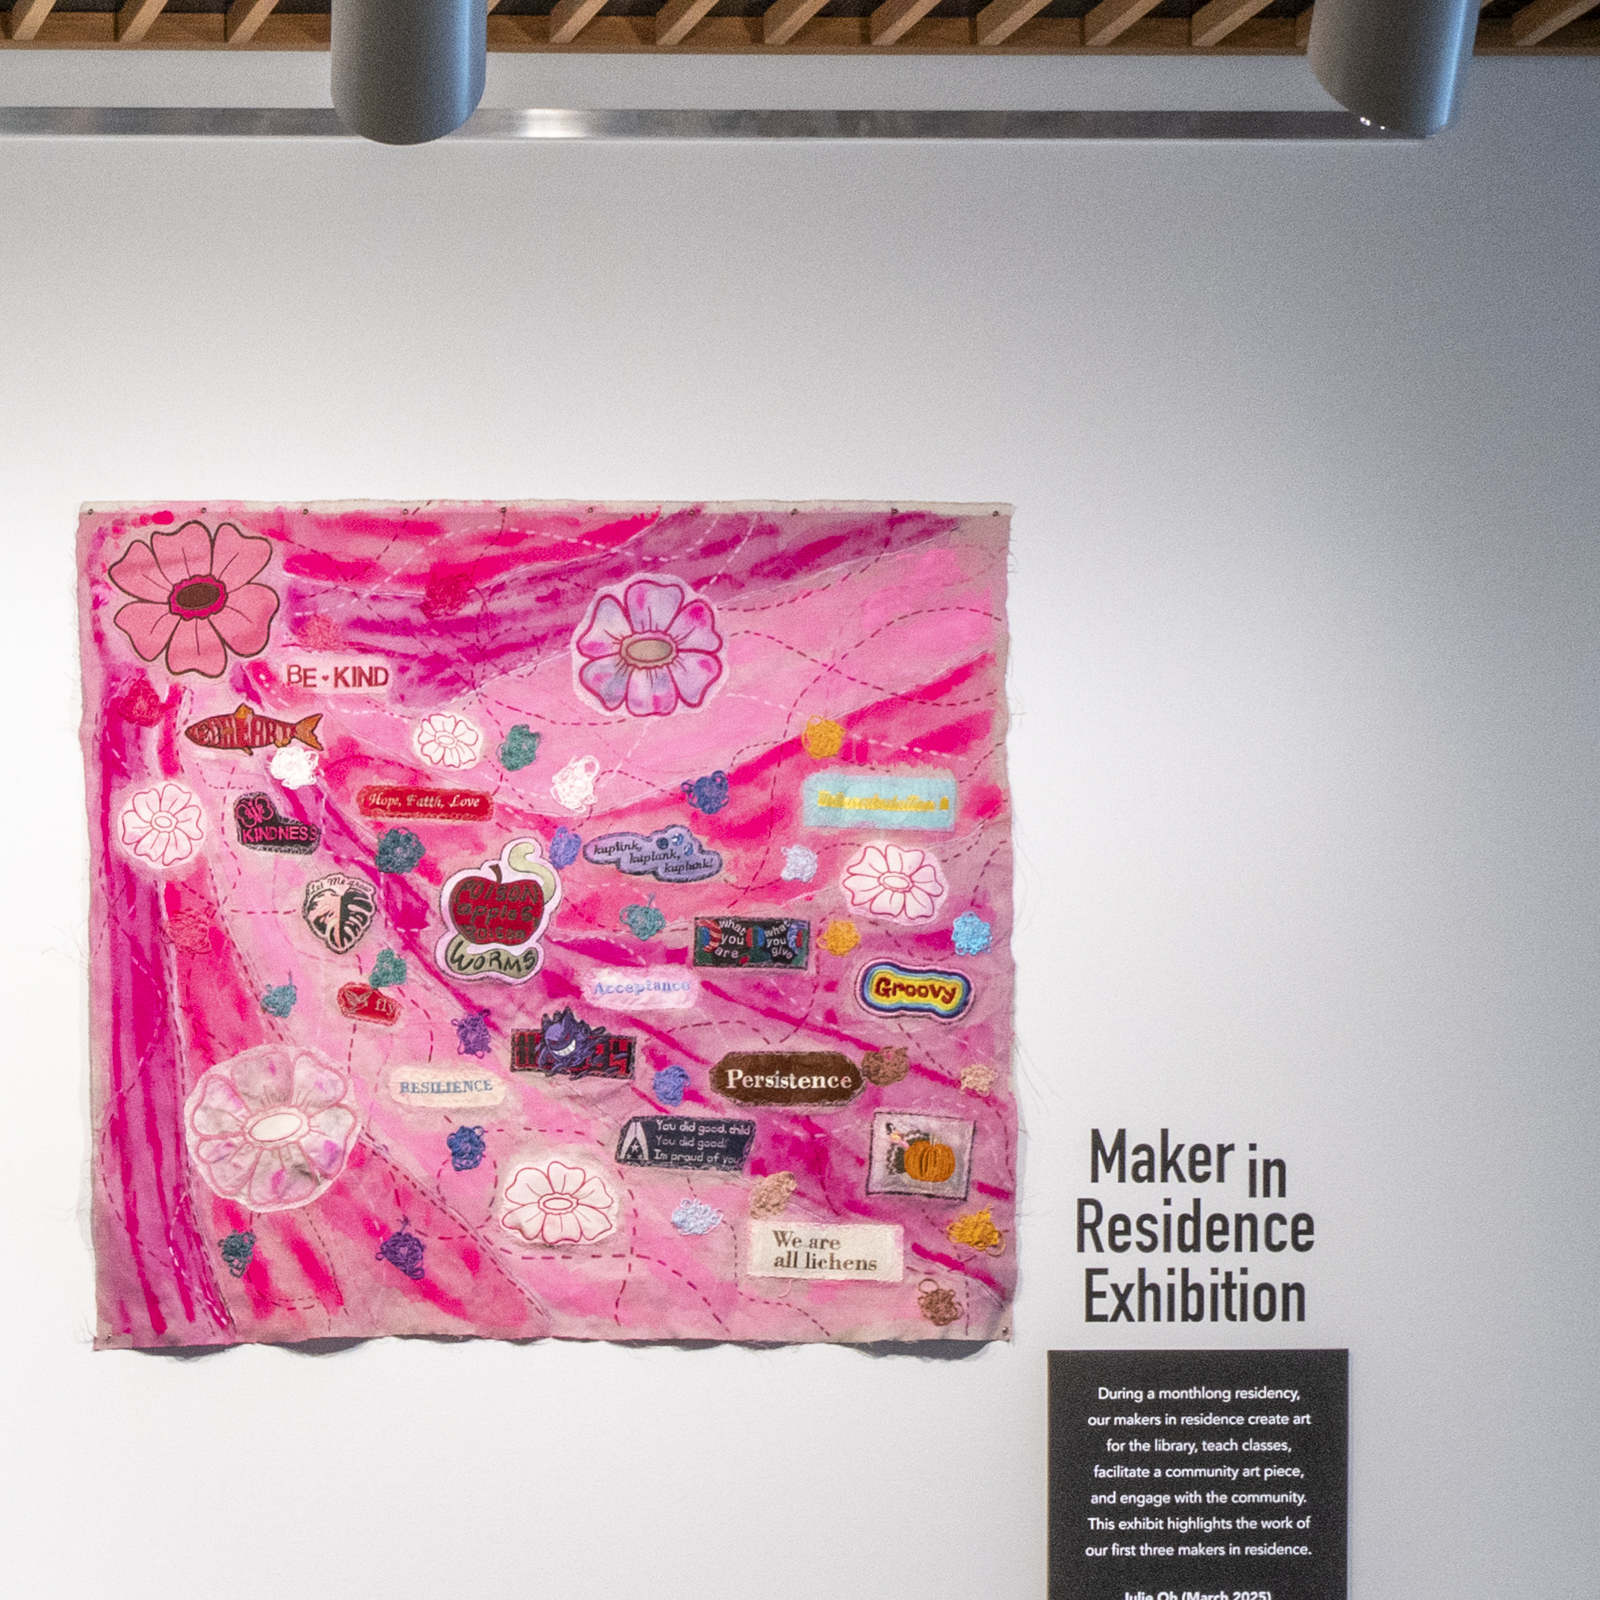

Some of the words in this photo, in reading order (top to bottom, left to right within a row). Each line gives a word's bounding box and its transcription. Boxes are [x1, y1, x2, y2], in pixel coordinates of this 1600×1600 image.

[286, 664, 317, 687] BE
[333, 665, 389, 688] KIND
[368, 791, 402, 810] Hope,
[449, 793, 481, 808] Love
[242, 825, 318, 844] KINDNESS
[455, 879, 540, 905] POISON
[719, 919, 747, 936] what
[720, 933, 745, 946] you
[766, 937, 787, 949] you
[714, 945, 740, 959] are
[771, 945, 794, 960] give
[593, 978, 691, 996] Acceptance
[874, 975, 958, 1005] Groovy
[373, 994, 399, 1017] fly
[399, 1078, 494, 1096] RESILIENCE
[726, 1068, 853, 1091] Persistence
[656, 1119, 677, 1131] You
[679, 1121, 696, 1132] did
[655, 1135, 676, 1146] You
[679, 1137, 695, 1147] did
[670, 1152, 704, 1163] proud
[706, 1152, 720, 1163] of
[1090, 1127, 1236, 1184] Maker
[1249, 1143, 1287, 1198] in
[1076, 1197, 1315, 1253] Residence
[773, 1231, 803, 1249] We
[809, 1236, 841, 1250] are
[773, 1252, 799, 1269] all
[804, 1252, 878, 1272] lichens
[1085, 1267, 1306, 1323] Exhibition
[1097, 1386, 1144, 1404] During
[1146, 1389, 1156, 1400] a
[1158, 1385, 1232, 1403] monthlong
[1234, 1385, 1301, 1403] residency,
[1087, 1416, 1112, 1427] our
[1113, 1412, 1162, 1426] makers
[1164, 1412, 1178, 1426] in
[1180, 1411, 1245, 1426] residence
[1247, 1413, 1290, 1426] create
[1292, 1413, 1312, 1426] art
[1105, 1437, 1127, 1453] for
[1128, 1438, 1152, 1453] the
[1154, 1438, 1199, 1456] library,
[1201, 1437, 1239, 1452] teach
[1241, 1437, 1292, 1455] classes,
[1093, 1464, 1151, 1479] facilitate
[1153, 1467, 1163, 1478] a
[1164, 1464, 1240, 1482] community
[1241, 1466, 1261, 1478] art
[1263, 1464, 1305, 1482] piece,
[1090, 1490, 1117, 1505] and
[1119, 1493, 1172, 1508] engage
[1173, 1489, 1203, 1504] with
[1205, 1489, 1229, 1504] the
[1230, 1490, 1308, 1508] community.
[1086, 1516, 1116, 1531] This
[1117, 1516, 1165, 1531] exhibit
[1166, 1516, 1233, 1534] highlights
[1235, 1516, 1259, 1530] the
[1260, 1515, 1294, 1530] work
[1295, 1515, 1312, 1530] of
[1084, 1546, 1109, 1557] our
[1110, 1541, 1137, 1557] first
[1138, 1542, 1175, 1557] three
[1177, 1542, 1226, 1557] makers
[1228, 1542, 1242, 1556] in
[1244, 1541, 1313, 1556] residence.
